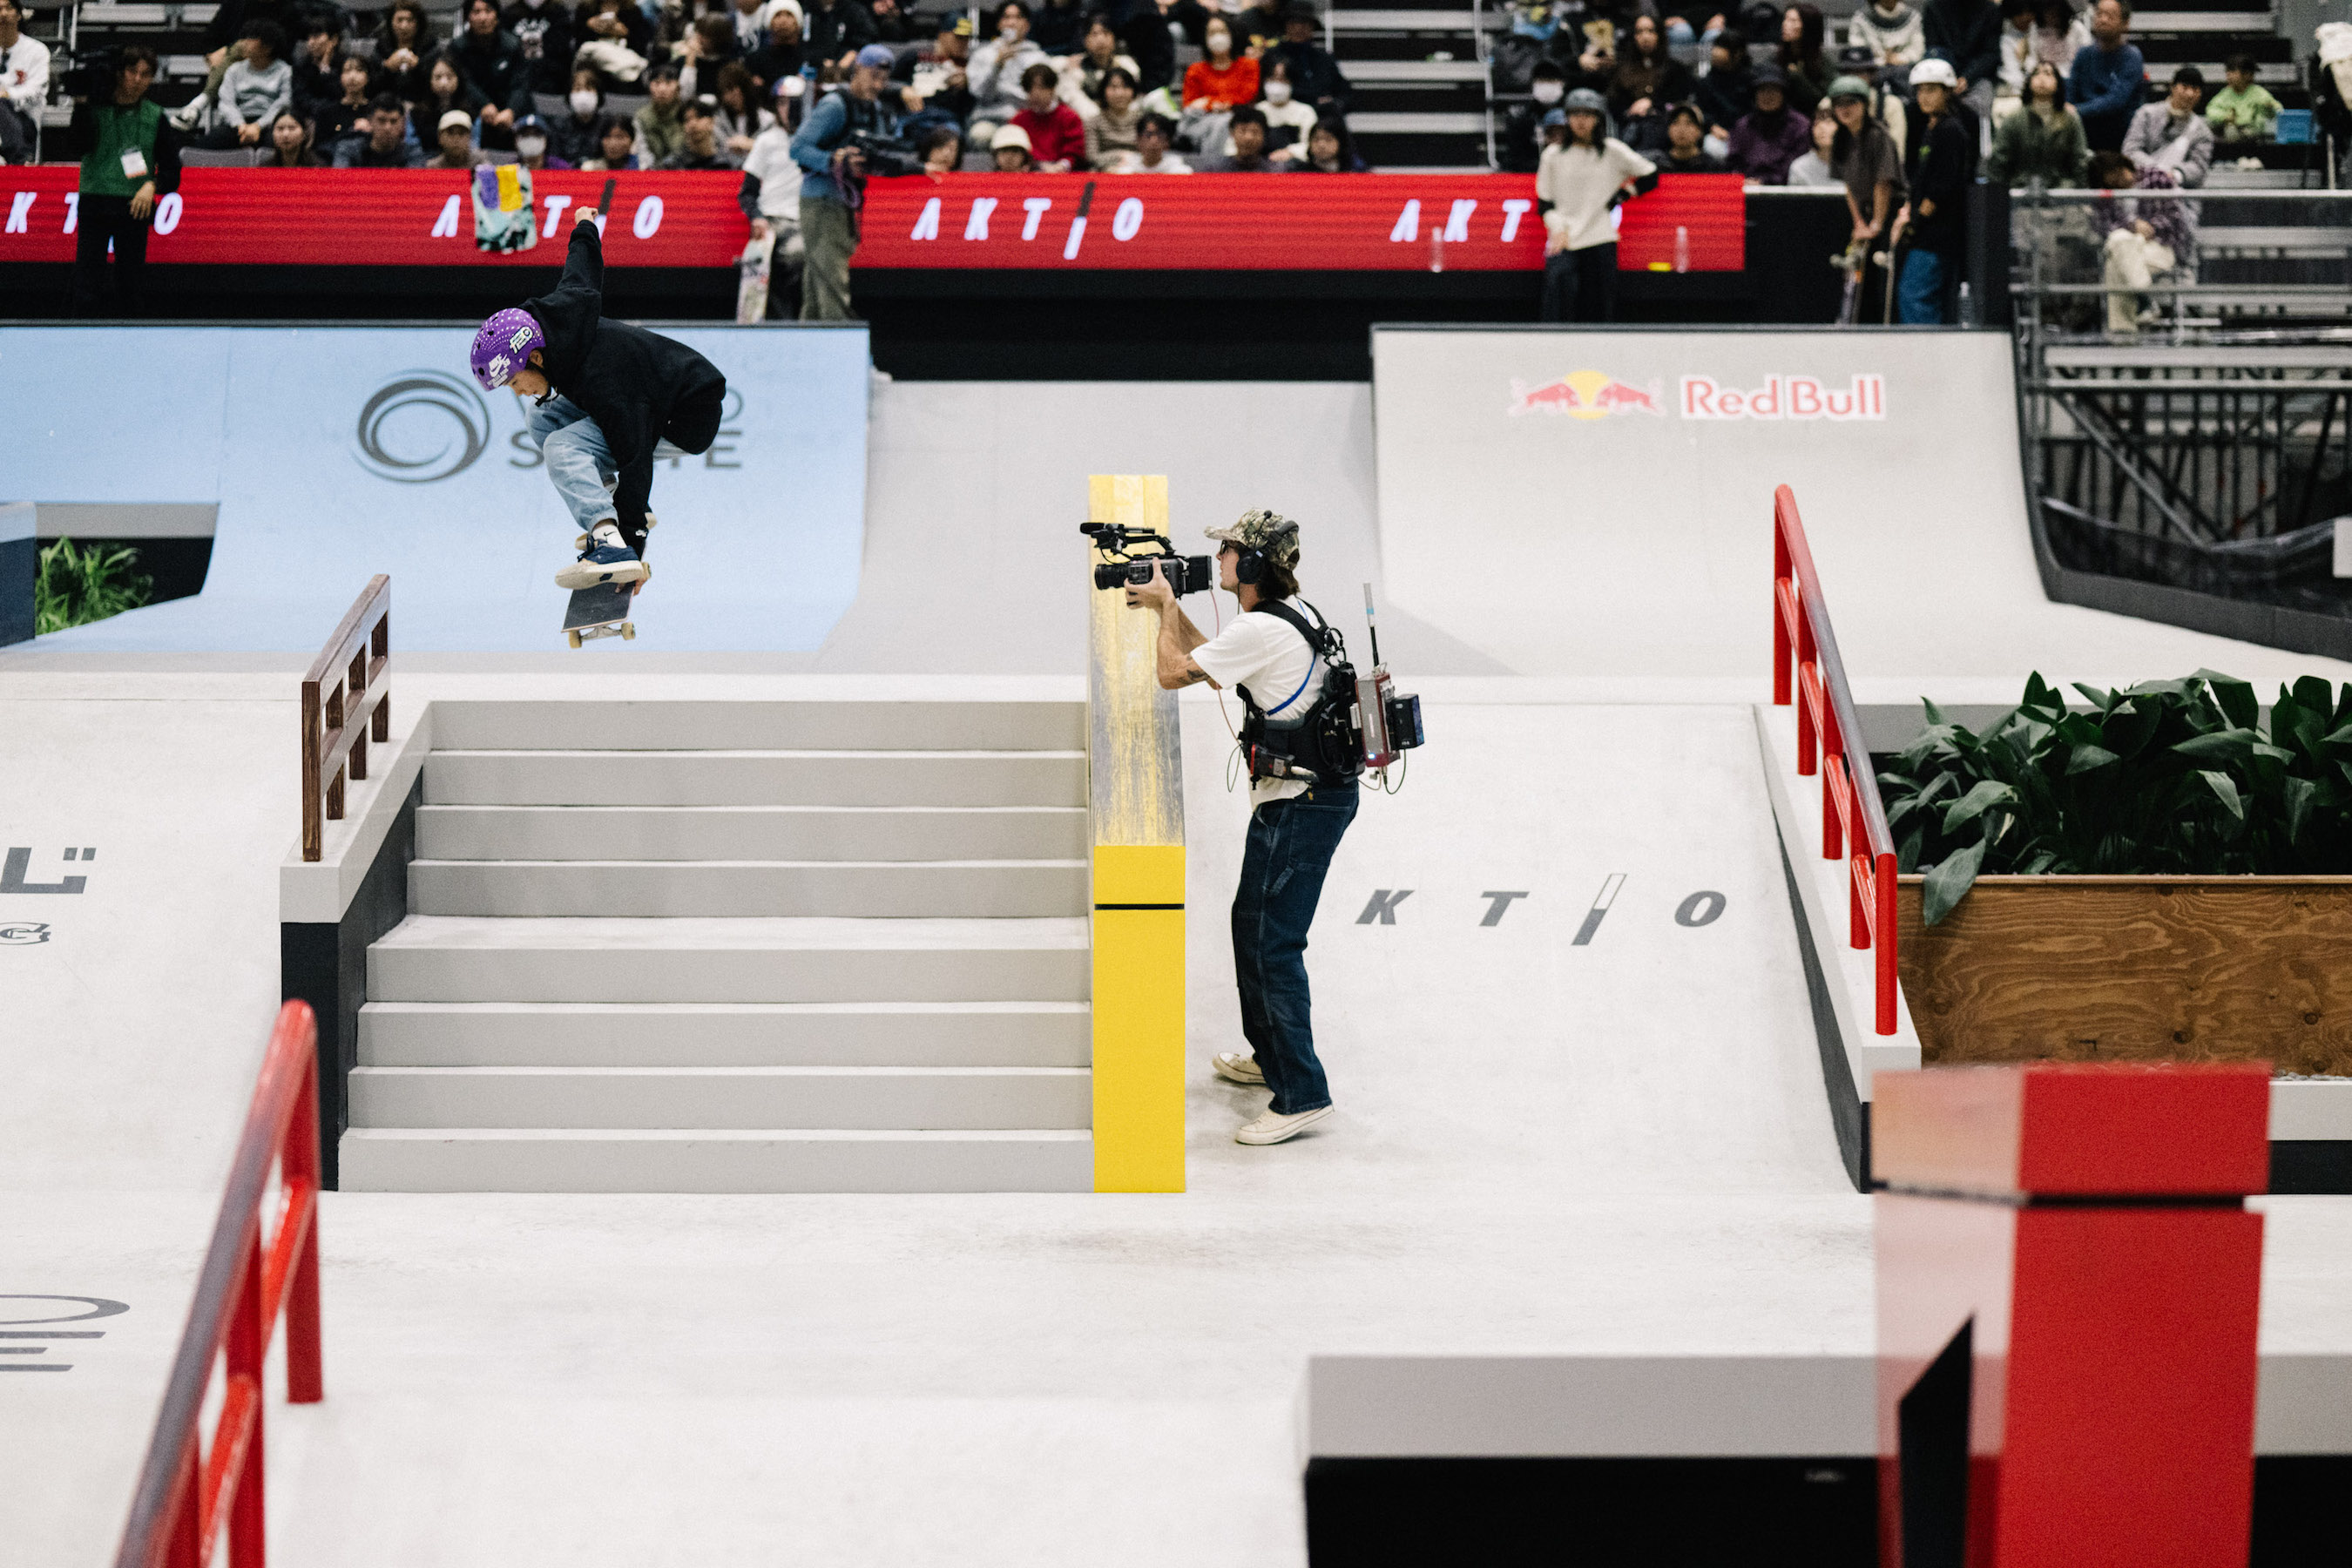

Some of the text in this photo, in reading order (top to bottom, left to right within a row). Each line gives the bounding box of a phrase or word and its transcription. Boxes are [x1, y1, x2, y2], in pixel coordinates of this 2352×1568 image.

[4, 191, 183, 253] KTO
[910, 181, 1144, 260] AKTIO
[1686, 379, 1882, 416] Red Bull
[1355, 873, 1727, 946] KTIO
